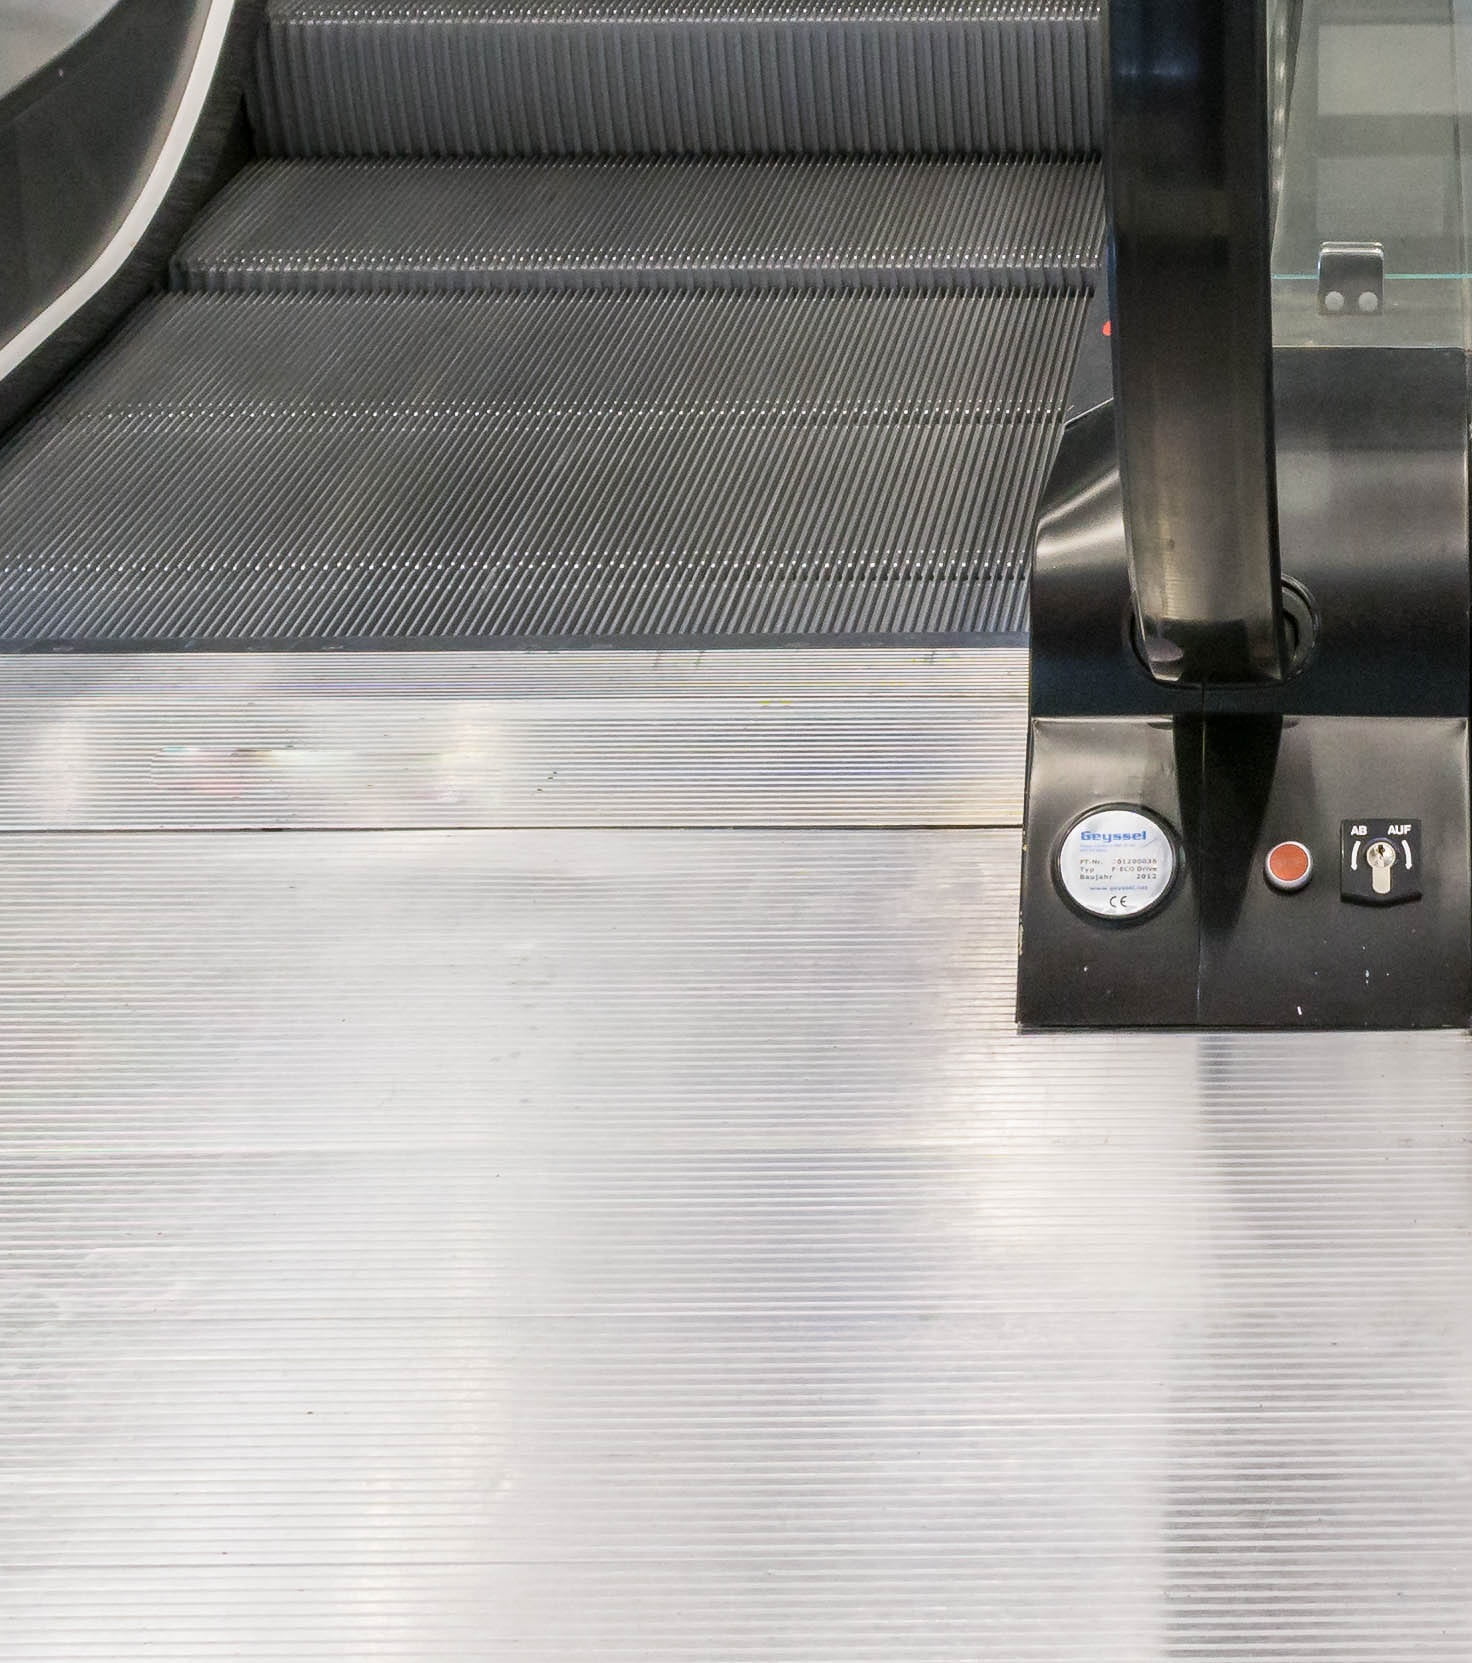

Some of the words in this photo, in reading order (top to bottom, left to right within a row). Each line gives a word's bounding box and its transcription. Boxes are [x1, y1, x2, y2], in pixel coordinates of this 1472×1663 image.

[1350, 825, 1368, 836] AB
[1387, 824, 1412, 835] AUF
[1080, 830, 1147, 843] Geyssel
